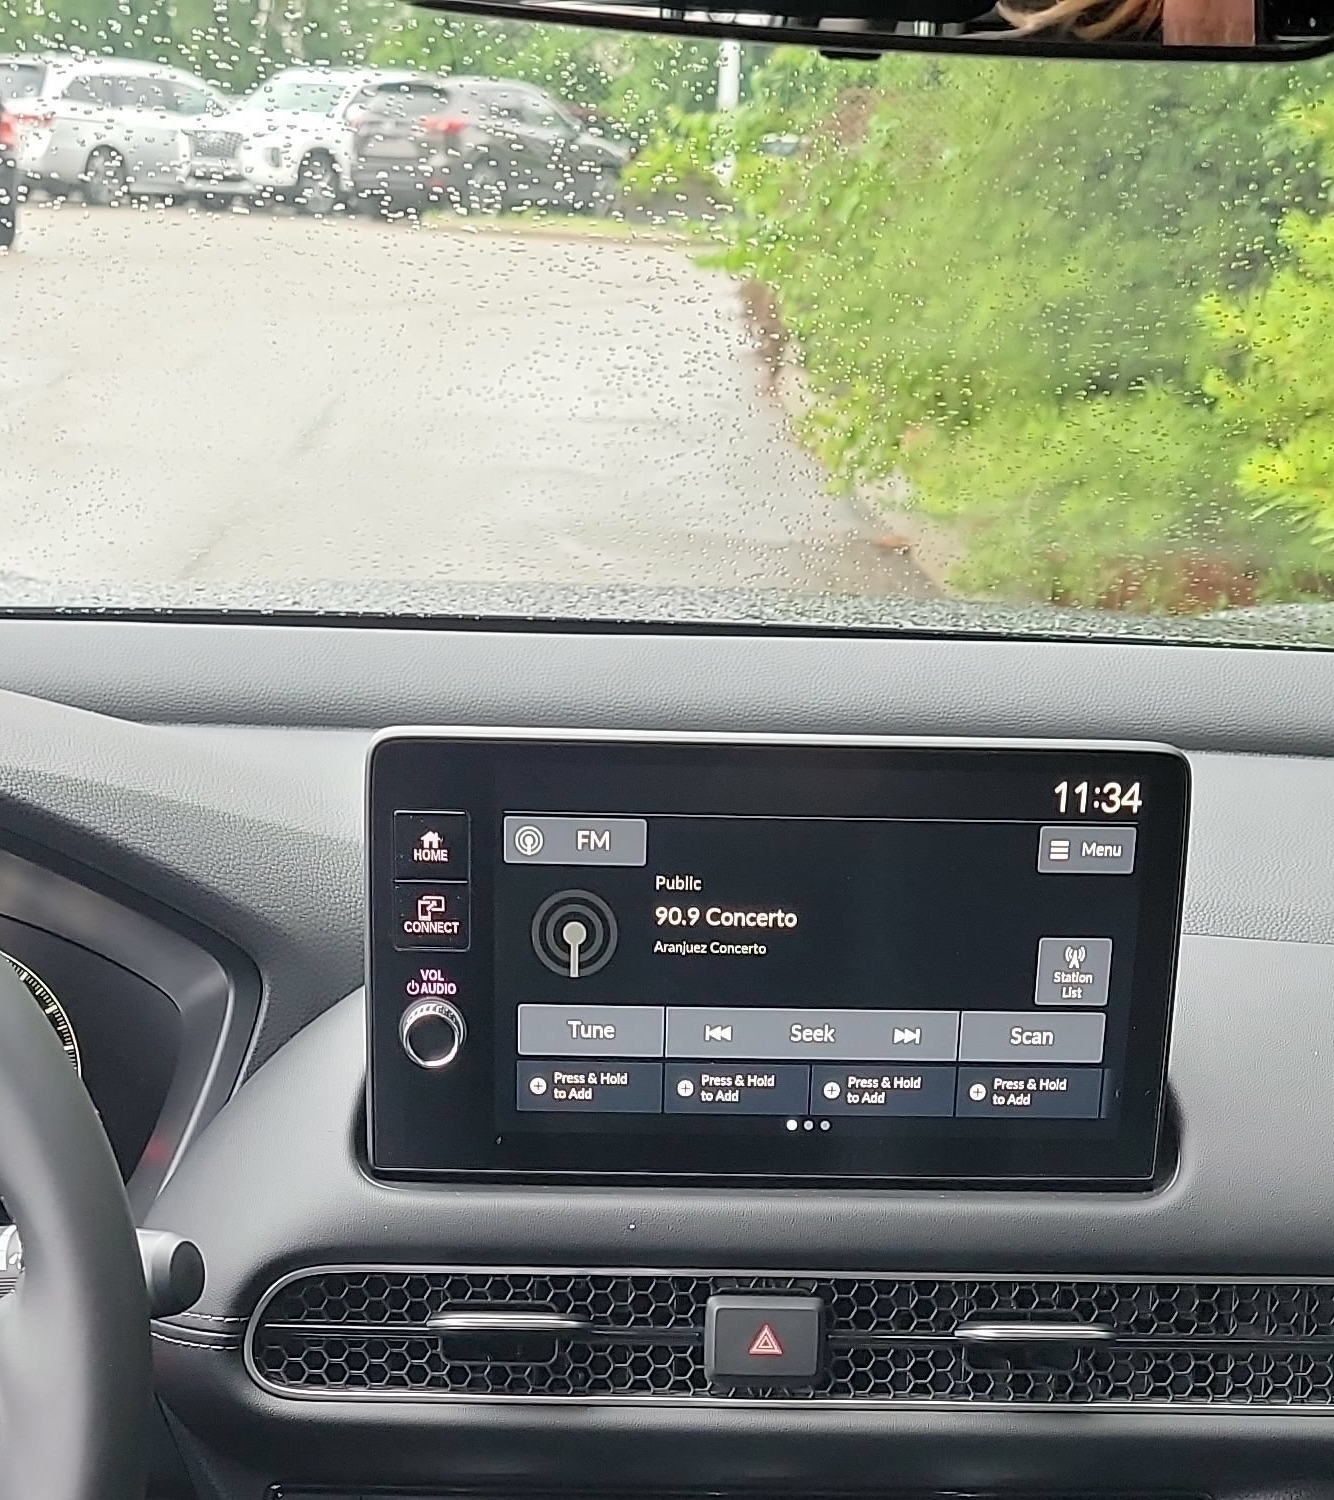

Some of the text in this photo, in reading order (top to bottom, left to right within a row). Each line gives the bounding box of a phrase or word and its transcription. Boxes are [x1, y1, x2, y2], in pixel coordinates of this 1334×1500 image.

[1054, 781, 1142, 813] 11:34
[576, 831, 611, 851] FM
[413, 849, 448, 862] HOME
[1081, 841, 1123, 857] Menu
[655, 875, 702, 891] Public
[655, 906, 798, 928] 90.9 Concerto
[403, 921, 460, 934] CONNECT
[653, 940, 767, 956] Aranjuez Concerto
[420, 969, 445, 982] VOL
[1053, 971, 1093, 984] Station
[420, 983, 457, 995] AUDIO
[1061, 986, 1083, 999] List
[567, 1020, 615, 1039] Tune
[790, 1024, 835, 1043] Seek
[1010, 1027, 1055, 1046] Scan
[553, 1071, 628, 1086] Press & Hold
[701, 1074, 775, 1088] Press & Hold
[847, 1076, 922, 1090] Press & Hold
[993, 1078, 1067, 1091] Press & Hold
[553, 1087, 593, 1100] to Add
[701, 1090, 739, 1102] to Add
[847, 1092, 886, 1104] to Add
[992, 1093, 1031, 1106] to Add
